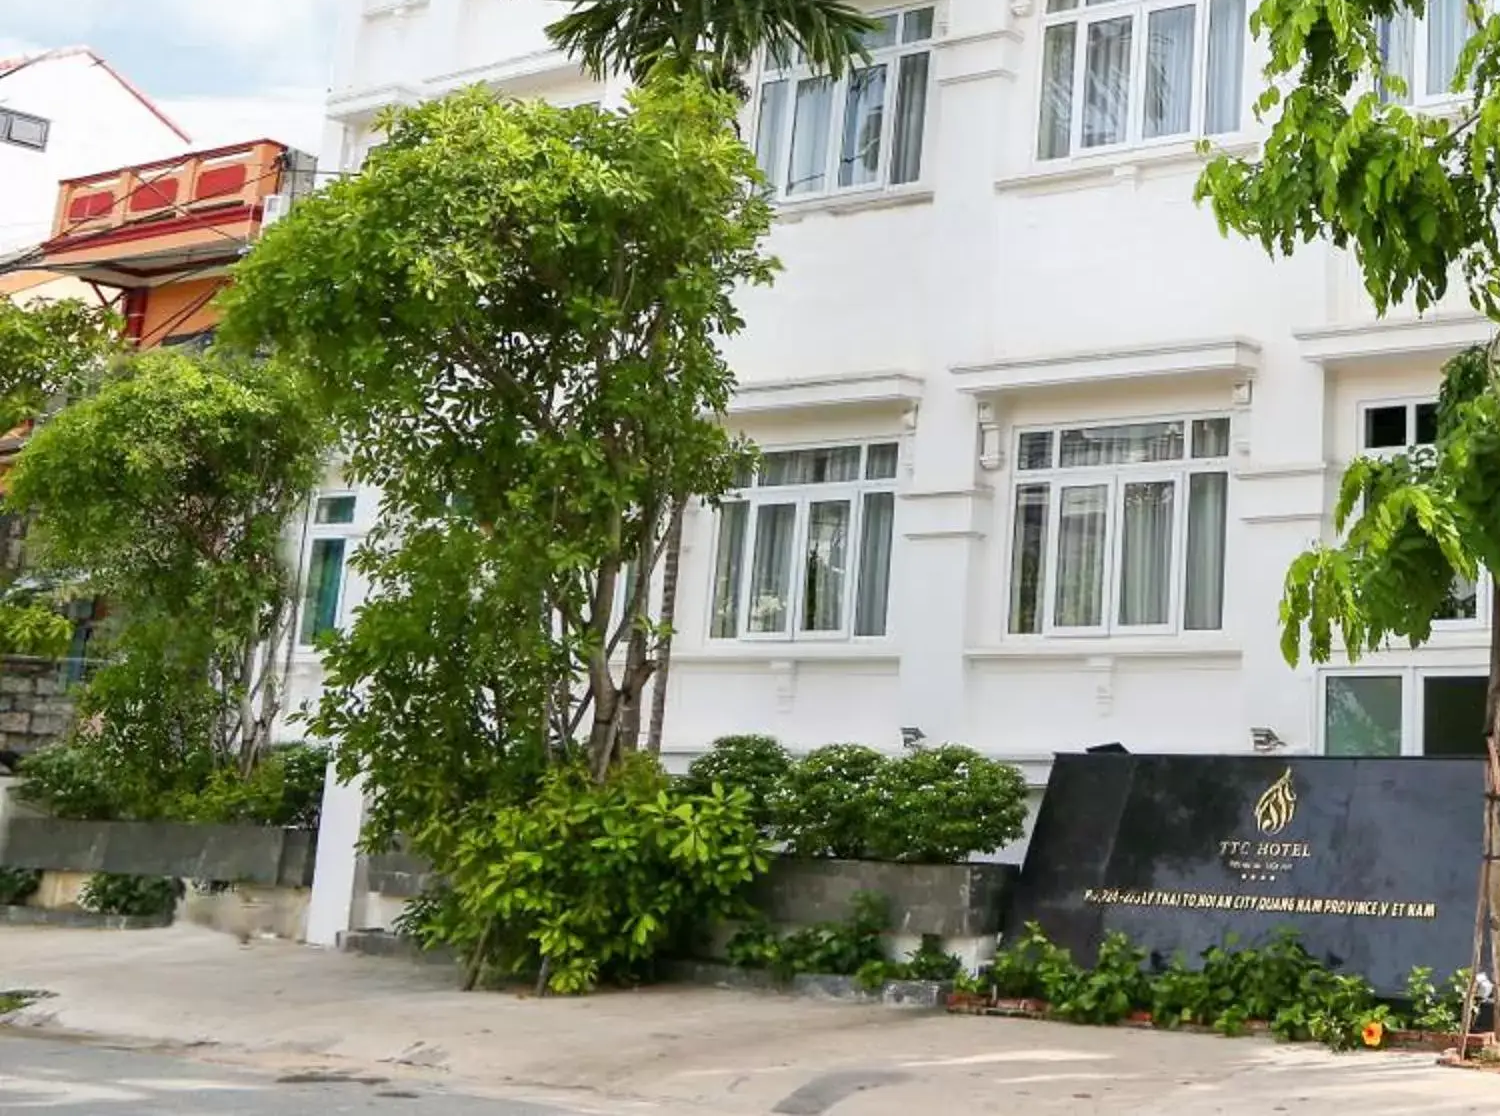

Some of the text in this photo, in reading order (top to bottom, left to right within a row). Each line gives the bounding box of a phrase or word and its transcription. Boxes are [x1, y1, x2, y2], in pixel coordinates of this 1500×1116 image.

[1220, 841, 1311, 857] TTC HOTEL
[1406, 903, 1436, 917] NAM
